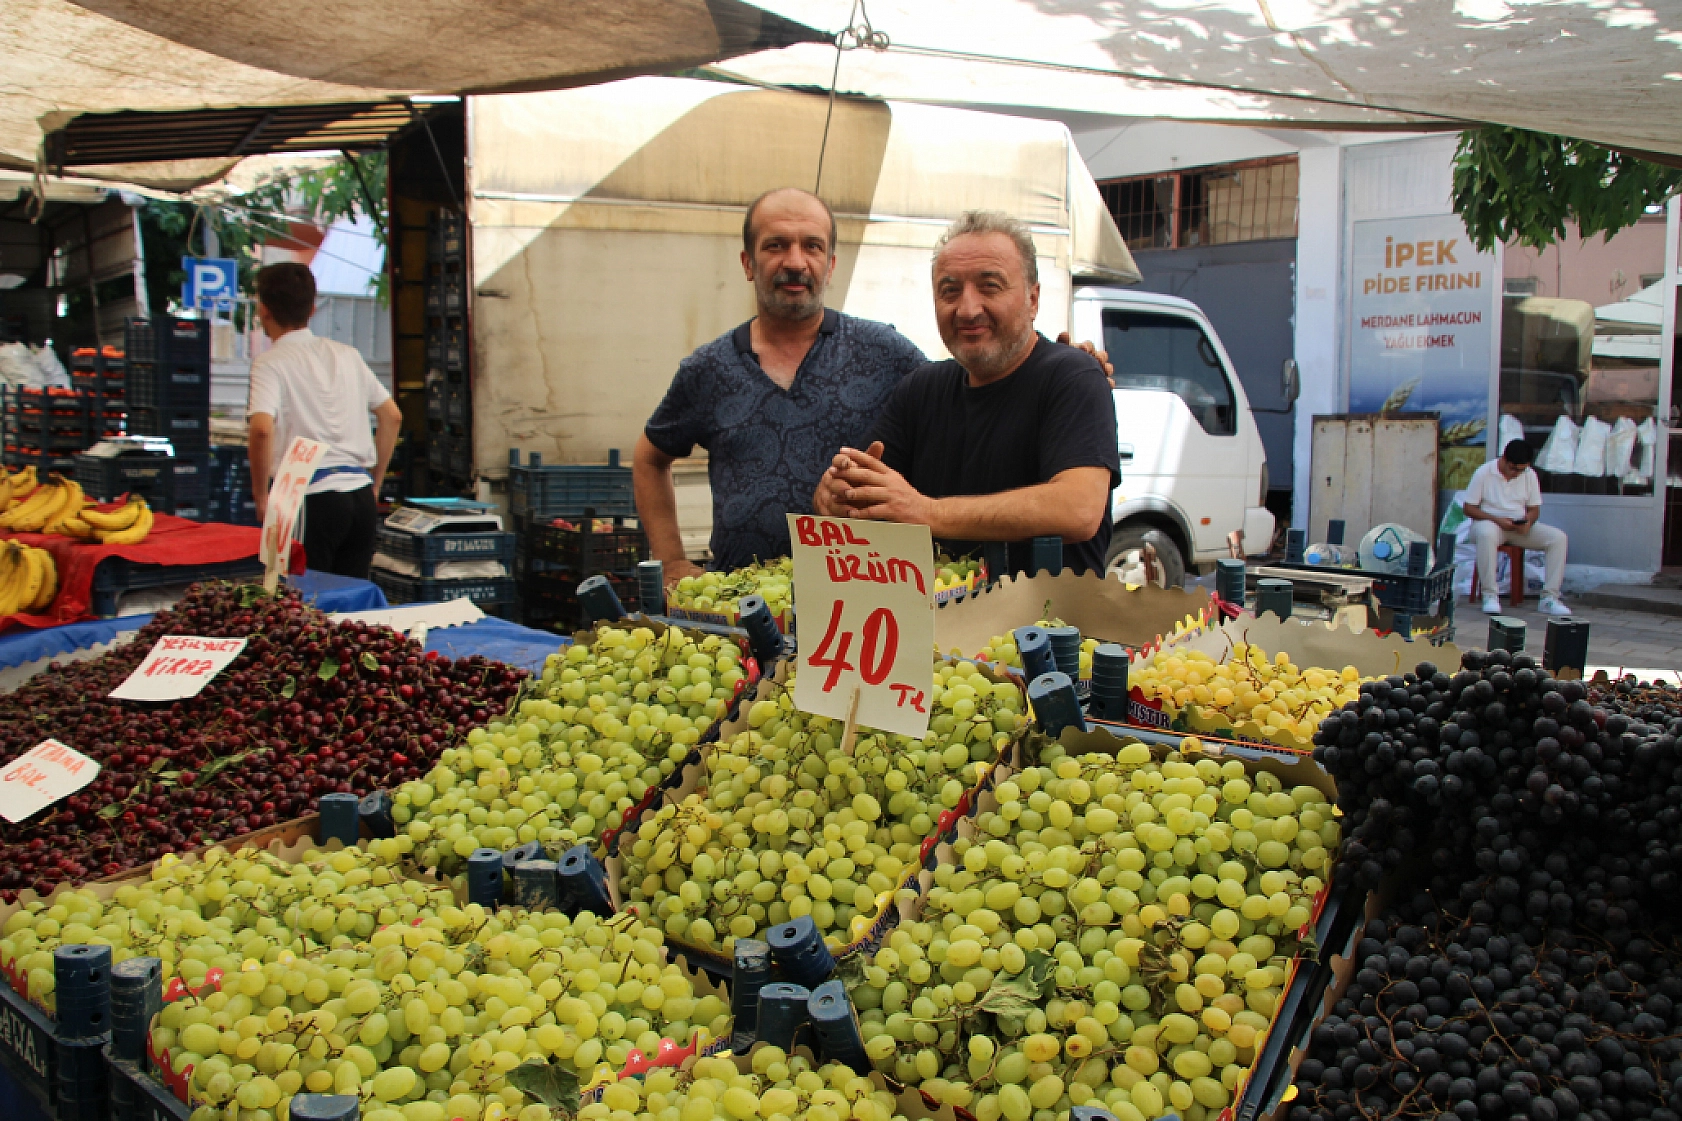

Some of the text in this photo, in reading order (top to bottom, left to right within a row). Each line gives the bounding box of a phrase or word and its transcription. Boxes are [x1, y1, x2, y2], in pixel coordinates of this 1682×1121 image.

[1385, 235, 1458, 268] İPEK
[194, 264, 226, 308] P
[1363, 271, 1481, 294] PİDE FIRINI
[1361, 310, 1482, 328] MERDANE LAHMACUN
[1416, 334, 1455, 348] EKMEK
[795, 516, 871, 546] BAL
[807, 599, 899, 693] 40
